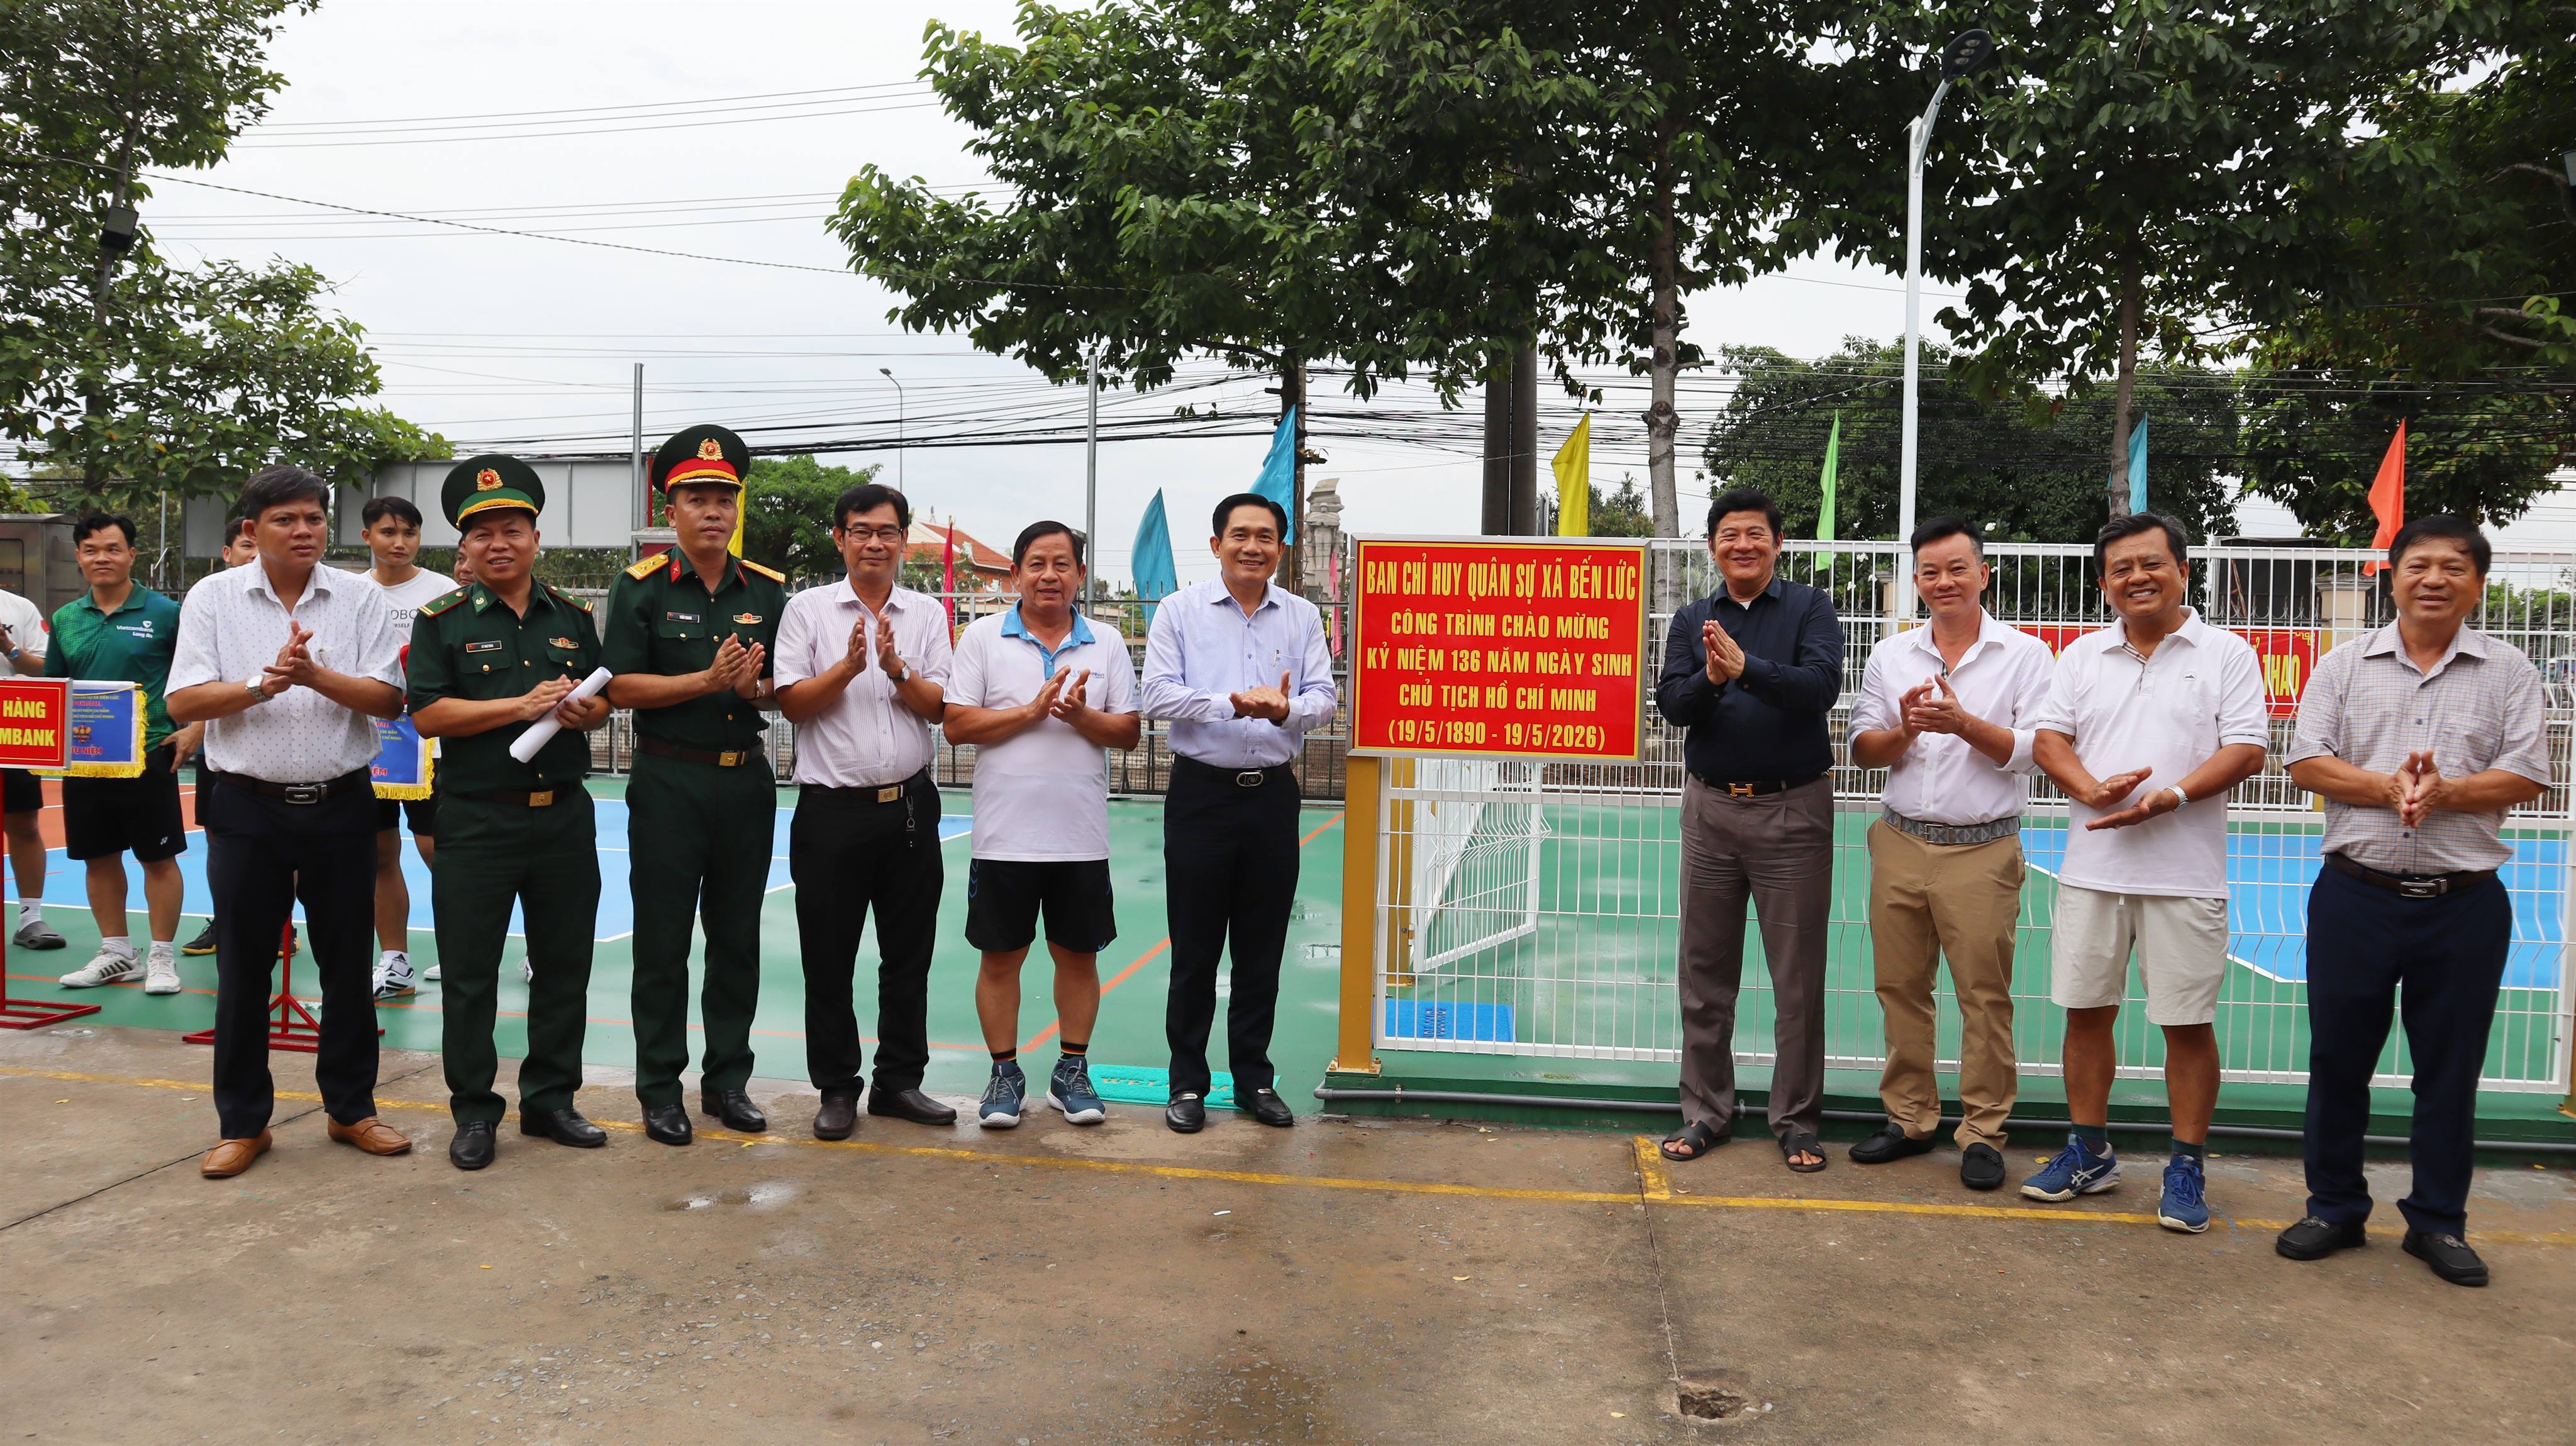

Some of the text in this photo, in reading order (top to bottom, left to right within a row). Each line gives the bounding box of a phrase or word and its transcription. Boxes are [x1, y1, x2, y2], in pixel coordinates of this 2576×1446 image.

[1367, 553, 1635, 604] BAN CHỈ HUY QUÂN SỰ XÃ BẾN LỨC
[1392, 609, 1608, 639] CÔNG TRÌNH CHÀO MỪNG
[1367, 642, 1631, 676] KỶ NIỆM 136 NĂM NGÀY SINH
[2262, 654, 2301, 696] THAO
[3, 696, 46, 718] HÀNG
[1400, 679, 1596, 711] CHỦ TỊCH HỒ CHÍ MINH
[1389, 720, 1485, 745] (19/5/1890
[1504, 723, 1604, 750] 19/5/2026)
[82, 744, 103, 758] NIỆM
